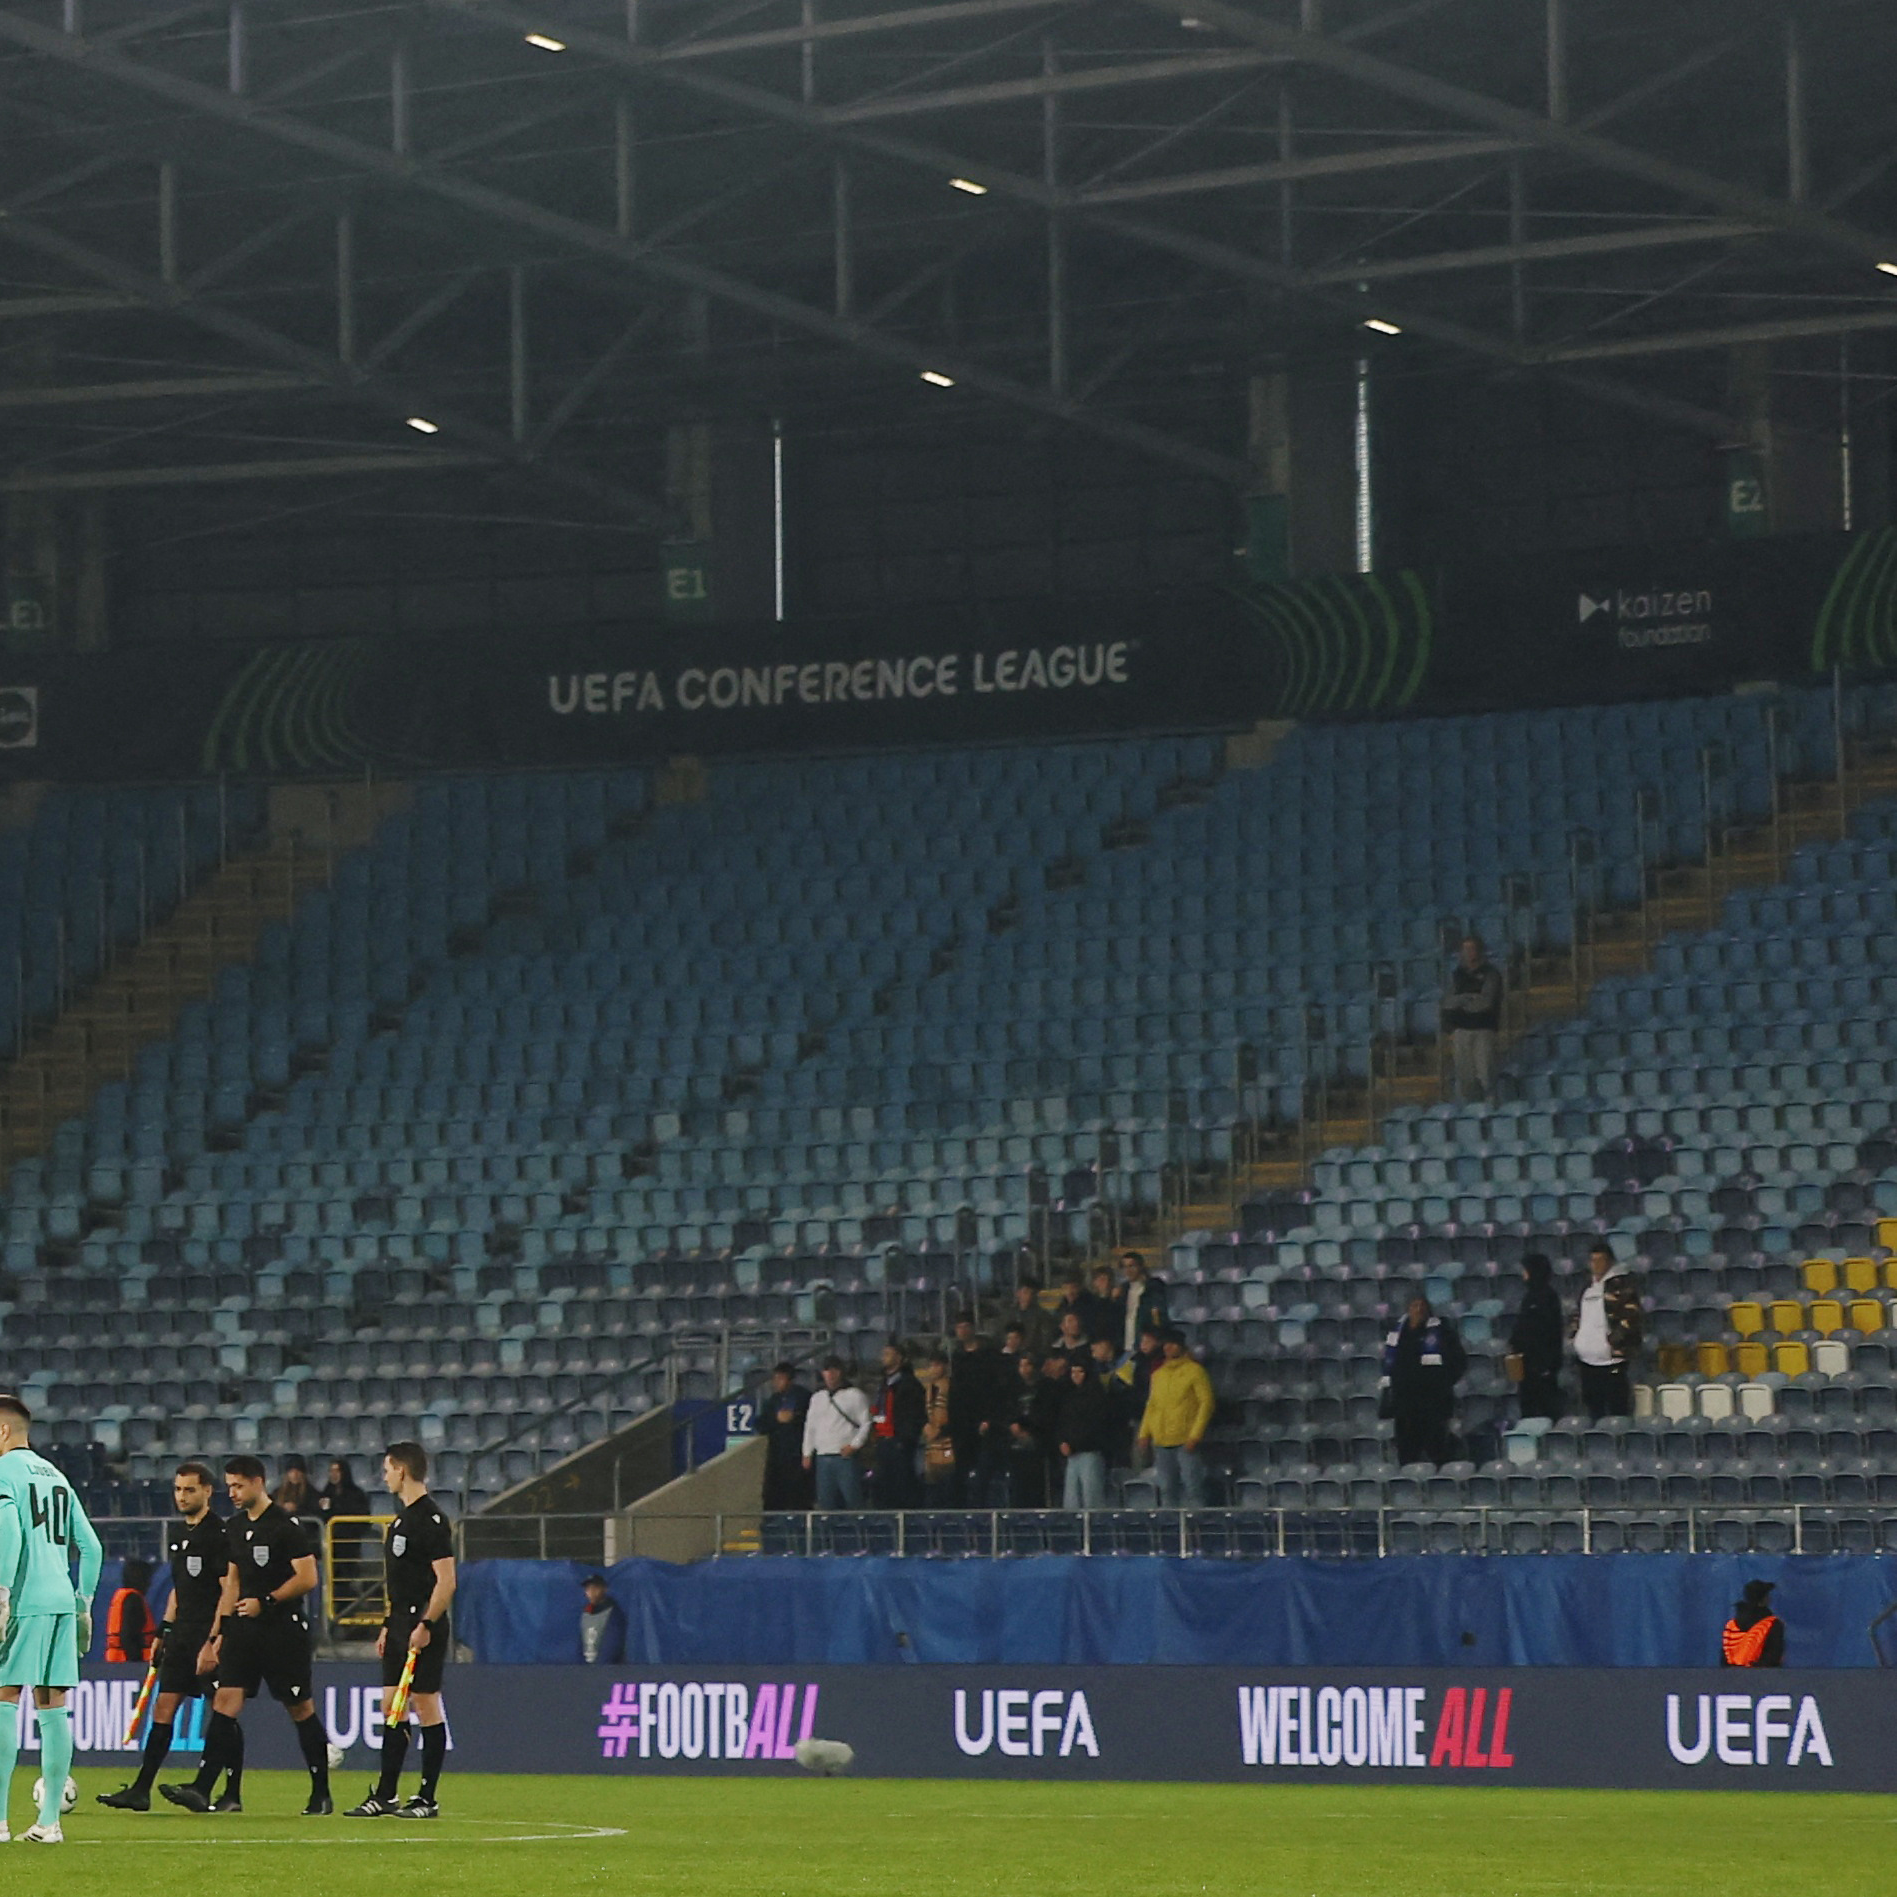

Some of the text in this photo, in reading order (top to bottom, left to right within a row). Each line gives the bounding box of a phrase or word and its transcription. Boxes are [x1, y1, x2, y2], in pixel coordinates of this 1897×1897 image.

[667, 568, 706, 599] E1
[548, 641, 1128, 715] UEFA CONFERENCE LEAGUE
[727, 1404, 753, 1432] E2
[29, 1482, 71, 1546] 40
[598, 1683, 819, 1759] #FOOTBALL
[954, 1689, 1100, 1756] UEFA
[1238, 1686, 1426, 1766] WELCOME
[1667, 1694, 1834, 1766] UEFA
